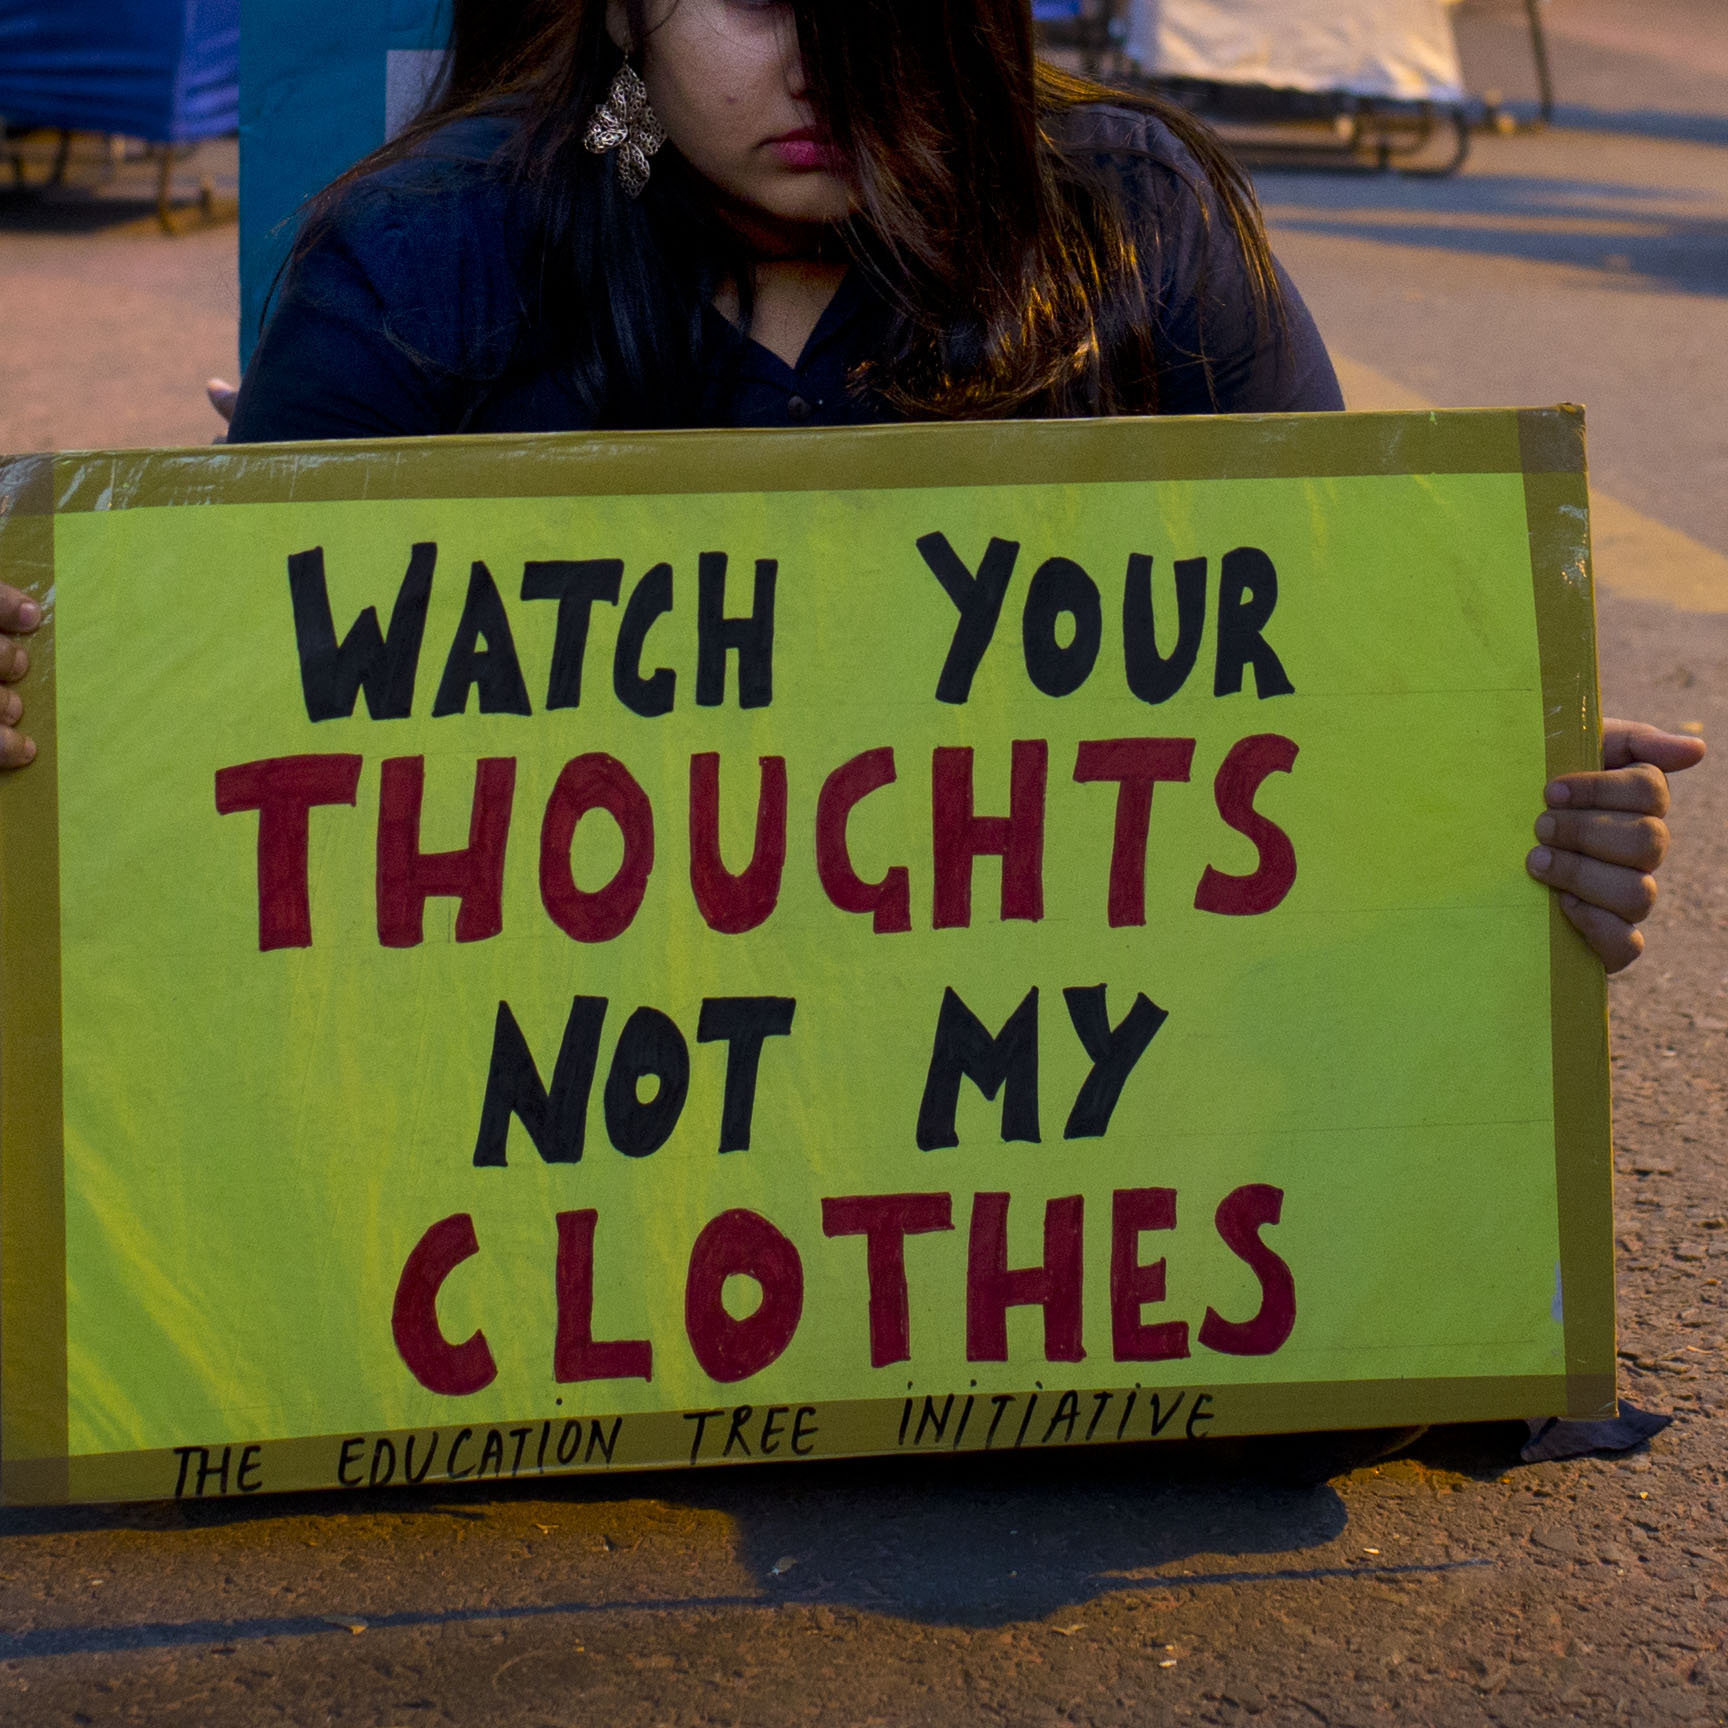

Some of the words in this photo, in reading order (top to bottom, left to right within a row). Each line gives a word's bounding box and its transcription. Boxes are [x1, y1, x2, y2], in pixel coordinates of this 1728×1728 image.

[287, 540, 777, 723] WATCH
[916, 531, 1296, 704] YOUR
[215, 733, 1300, 951] THOUGHTS
[473, 995, 796, 1169] NOT
[916, 984, 1169, 1152] MY
[390, 1184, 1298, 1396] CLOTHES
[173, 1445, 265, 1499] THE
[337, 1398, 622, 1489] EDUCATION
[682, 1406, 818, 1466] TREE
